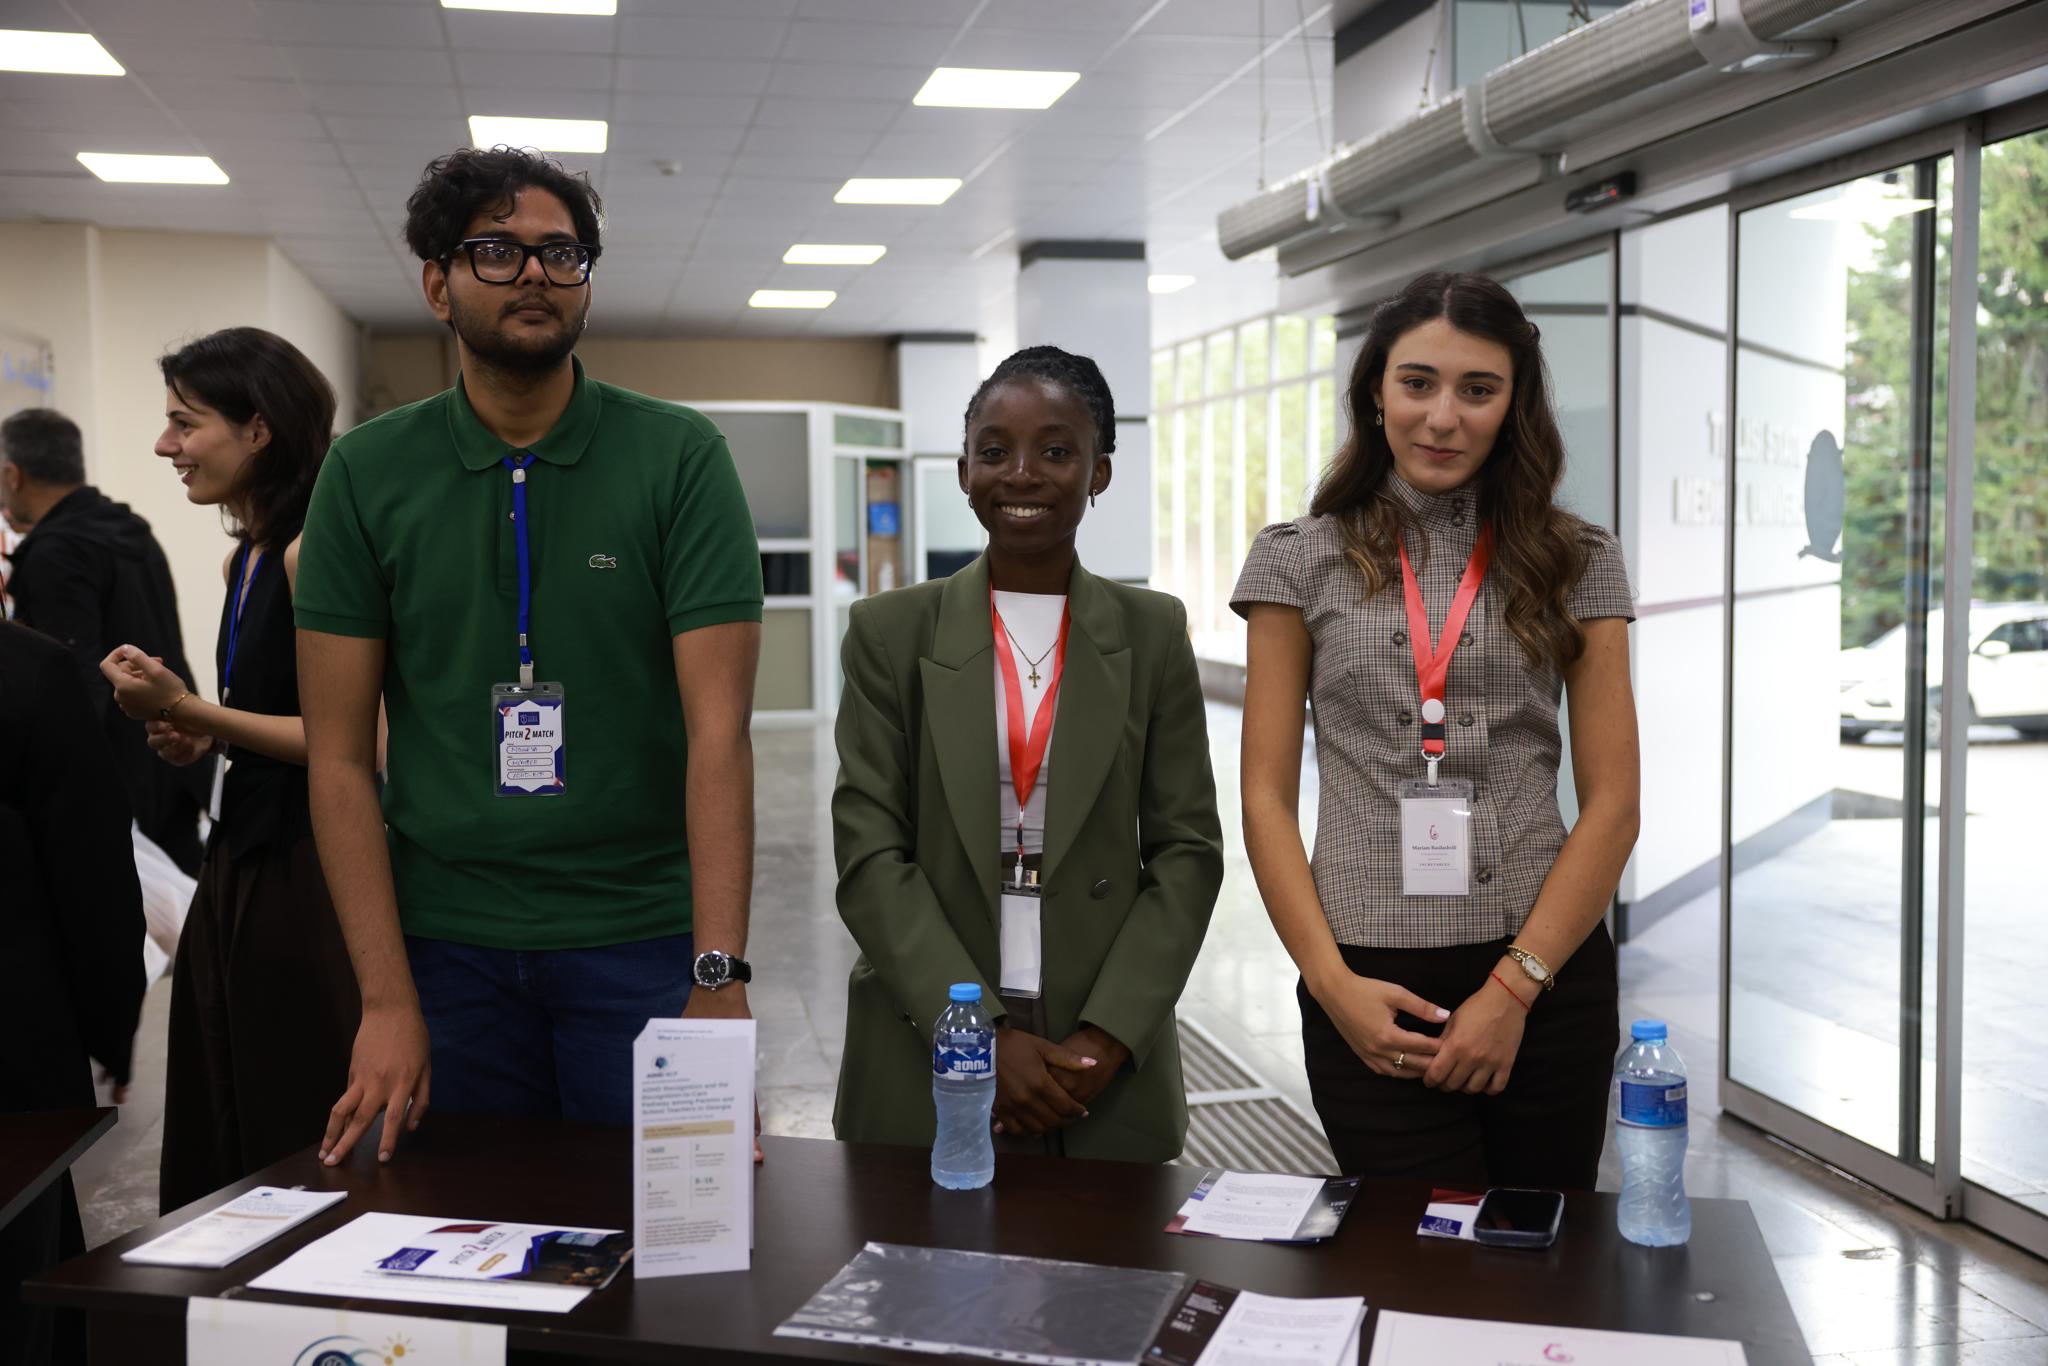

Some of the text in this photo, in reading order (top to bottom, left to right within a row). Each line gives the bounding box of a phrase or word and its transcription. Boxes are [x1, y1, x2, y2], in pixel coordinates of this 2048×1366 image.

[505, 727, 554, 740] PITCH 2 MATCH
[667, 1105, 697, 1113] Teachers
